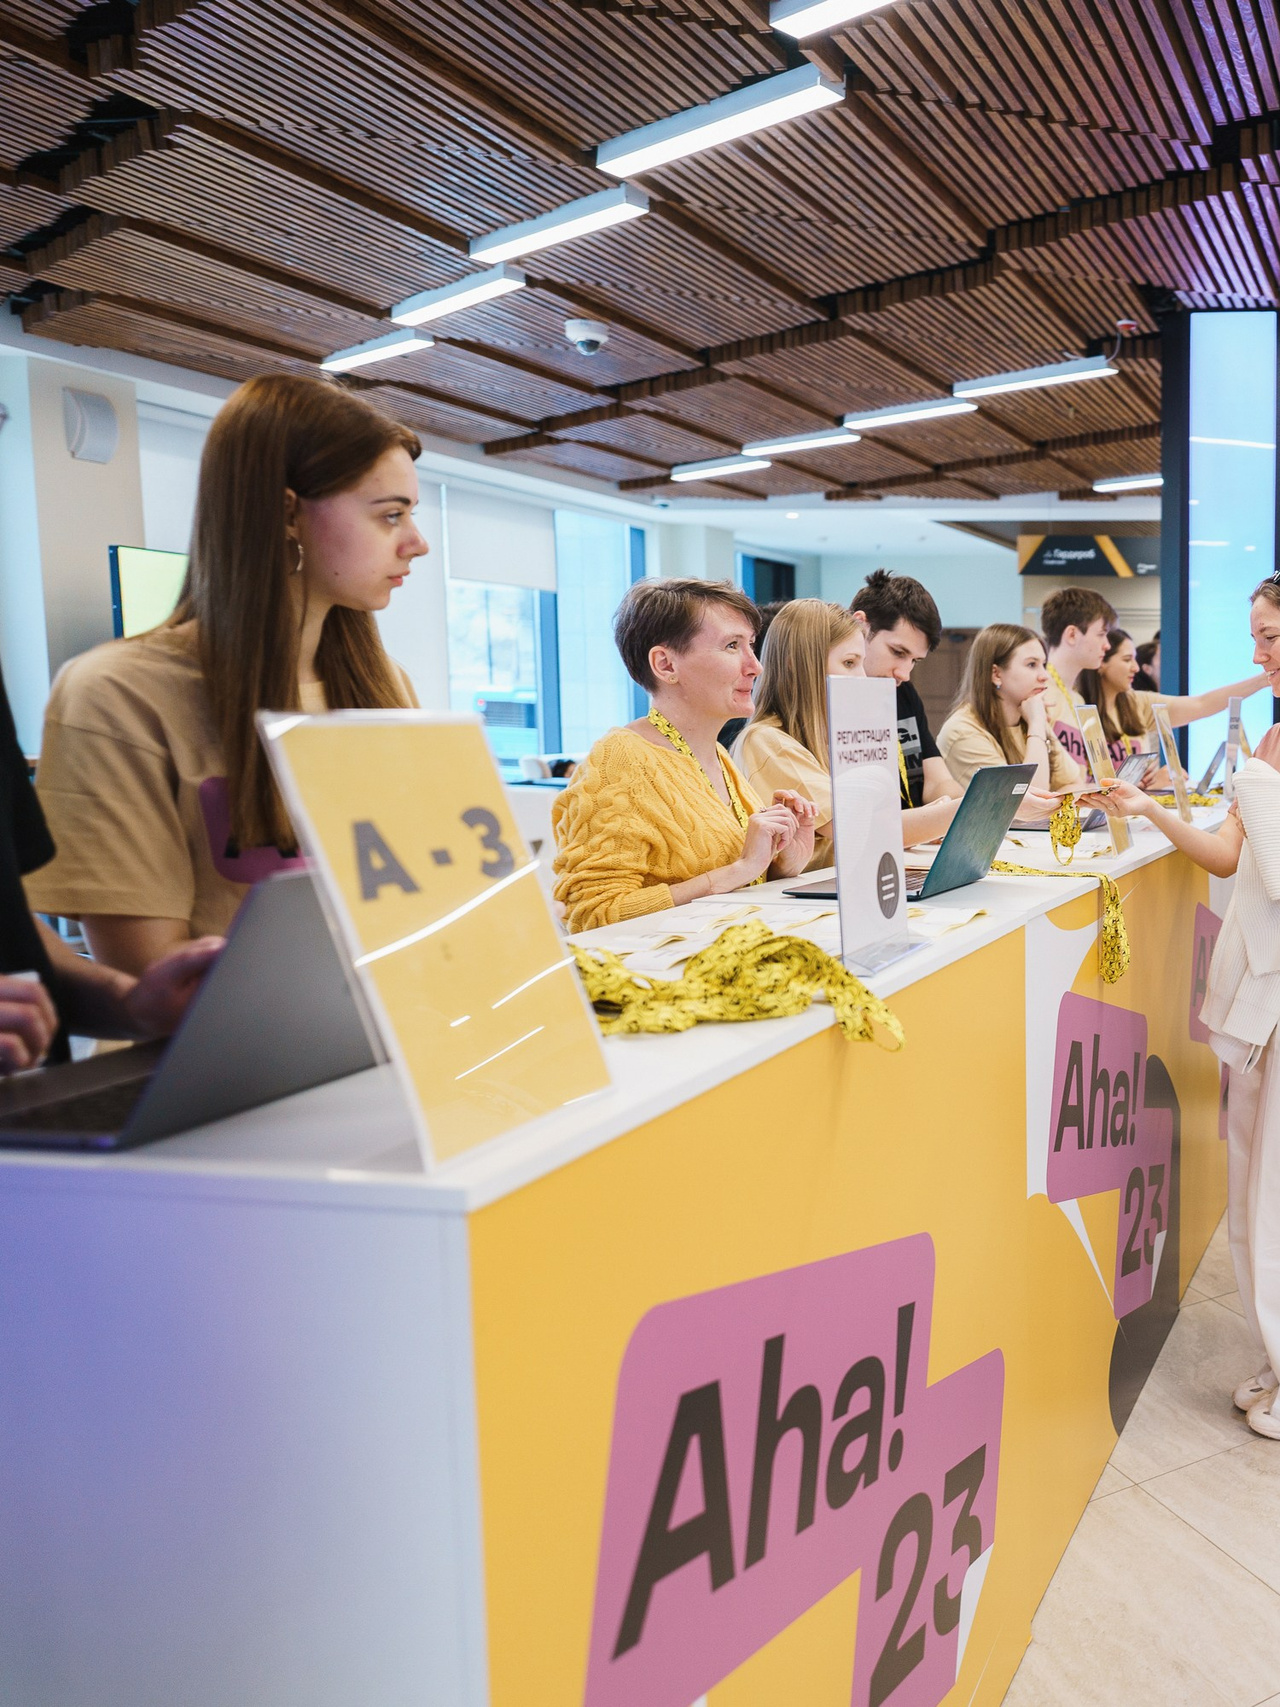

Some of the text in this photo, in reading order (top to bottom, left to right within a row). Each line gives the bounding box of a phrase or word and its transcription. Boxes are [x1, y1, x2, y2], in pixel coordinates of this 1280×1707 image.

[837, 729, 891, 745] РЕГИСТРАЦИЯ
[838, 747, 888, 764] УЧАСТНИКОВ
[1054, 1034, 1141, 1153] Aha!
[1120, 1163, 1165, 1278] 23
[610, 1301, 915, 1662] Aha!
[869, 1443, 987, 1707] 23
